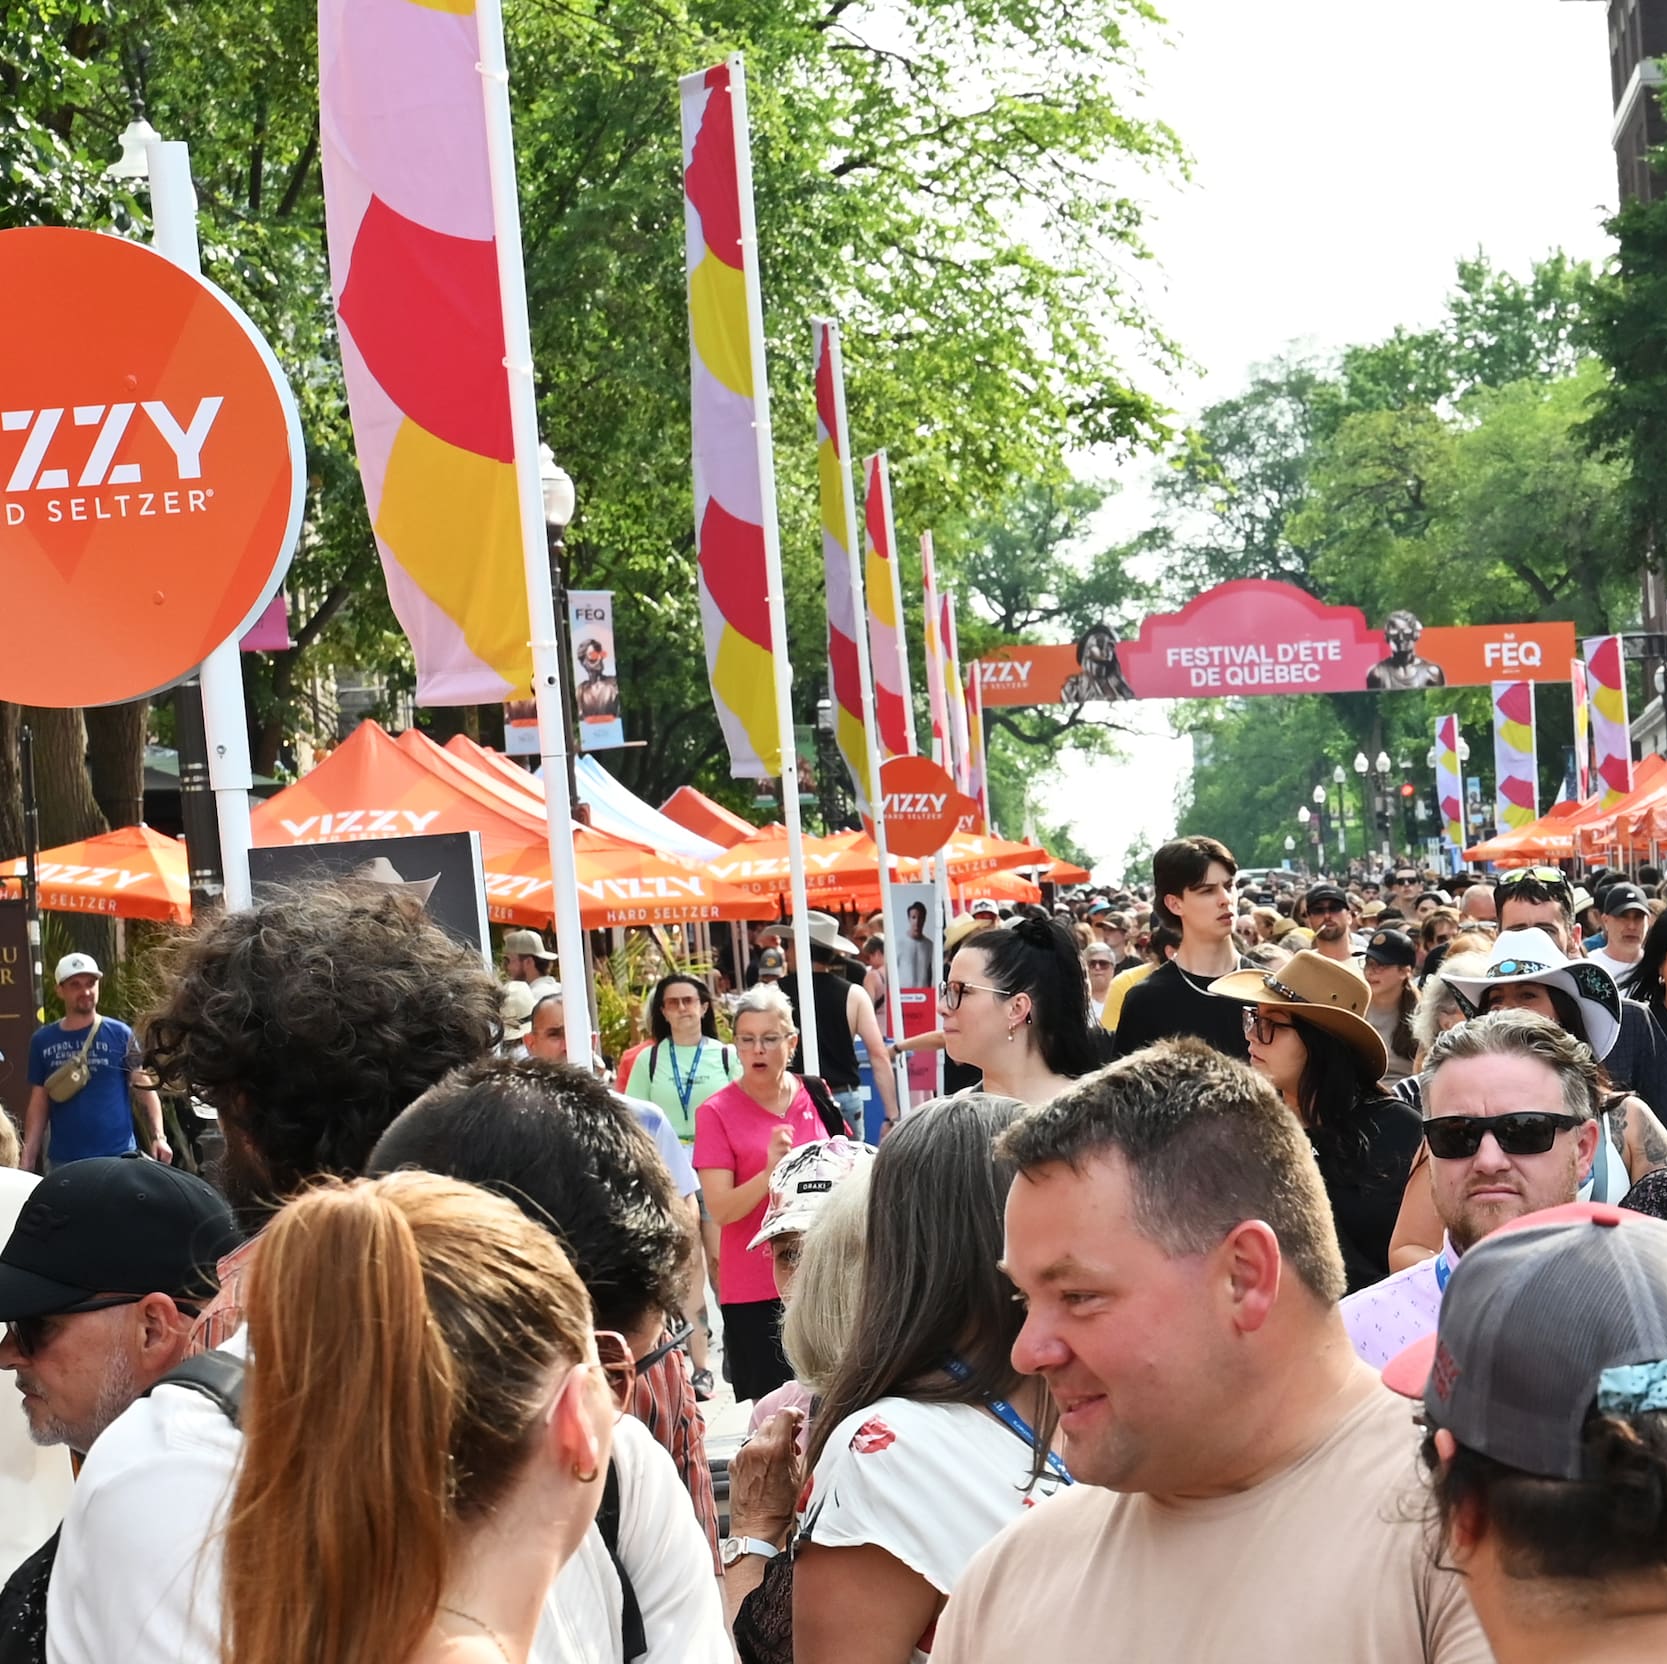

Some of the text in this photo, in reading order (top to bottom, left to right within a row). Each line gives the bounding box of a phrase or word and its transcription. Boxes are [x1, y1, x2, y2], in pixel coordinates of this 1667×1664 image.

[1, 396, 225, 492] ZZY
[1167, 645, 1274, 667] FESTIVAL
[1191, 667, 1221, 688] DE
[280, 810, 441, 837] VIZZY
[949, 858, 998, 875] ELTZER
[769, 874, 837, 891] SEZER
[50, 893, 118, 912] SELTZER
[607, 906, 720, 922] HARD SELTZER
[802, 1183, 826, 1191] ORAKI
